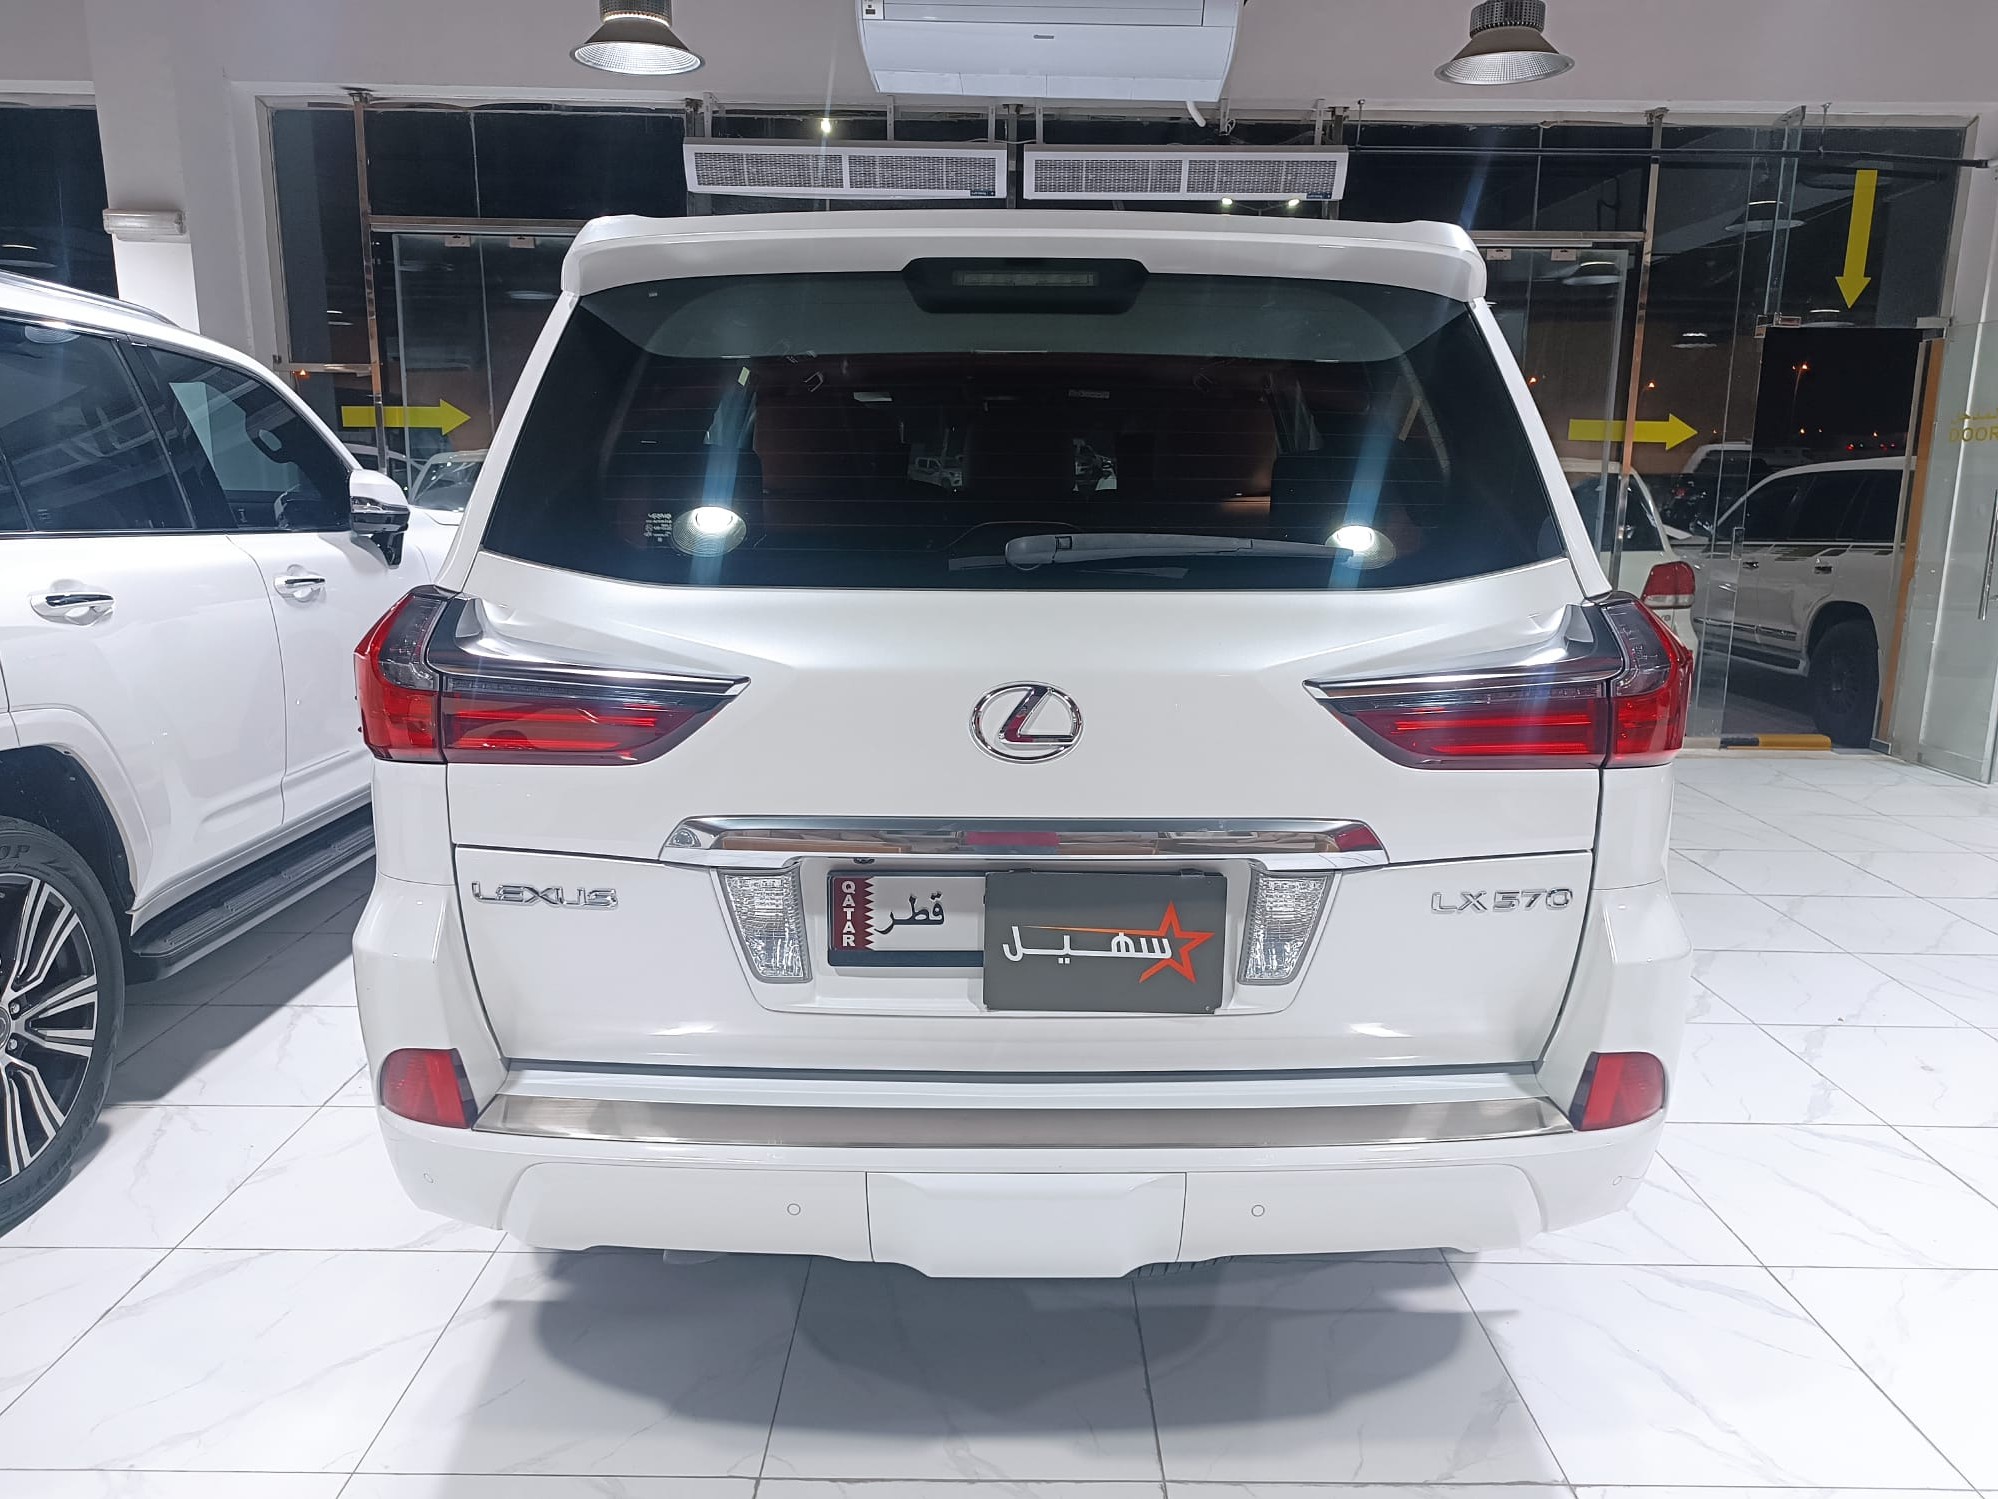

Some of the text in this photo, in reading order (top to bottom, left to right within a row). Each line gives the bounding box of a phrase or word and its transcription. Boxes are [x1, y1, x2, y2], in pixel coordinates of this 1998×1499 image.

[471, 881, 619, 910] LEXUS
[841, 880, 856, 947] QATAR
[873, 890, 945, 935] قطر
[1431, 887, 1574, 914] LX 570
[1002, 925, 1172, 965] سهيل
